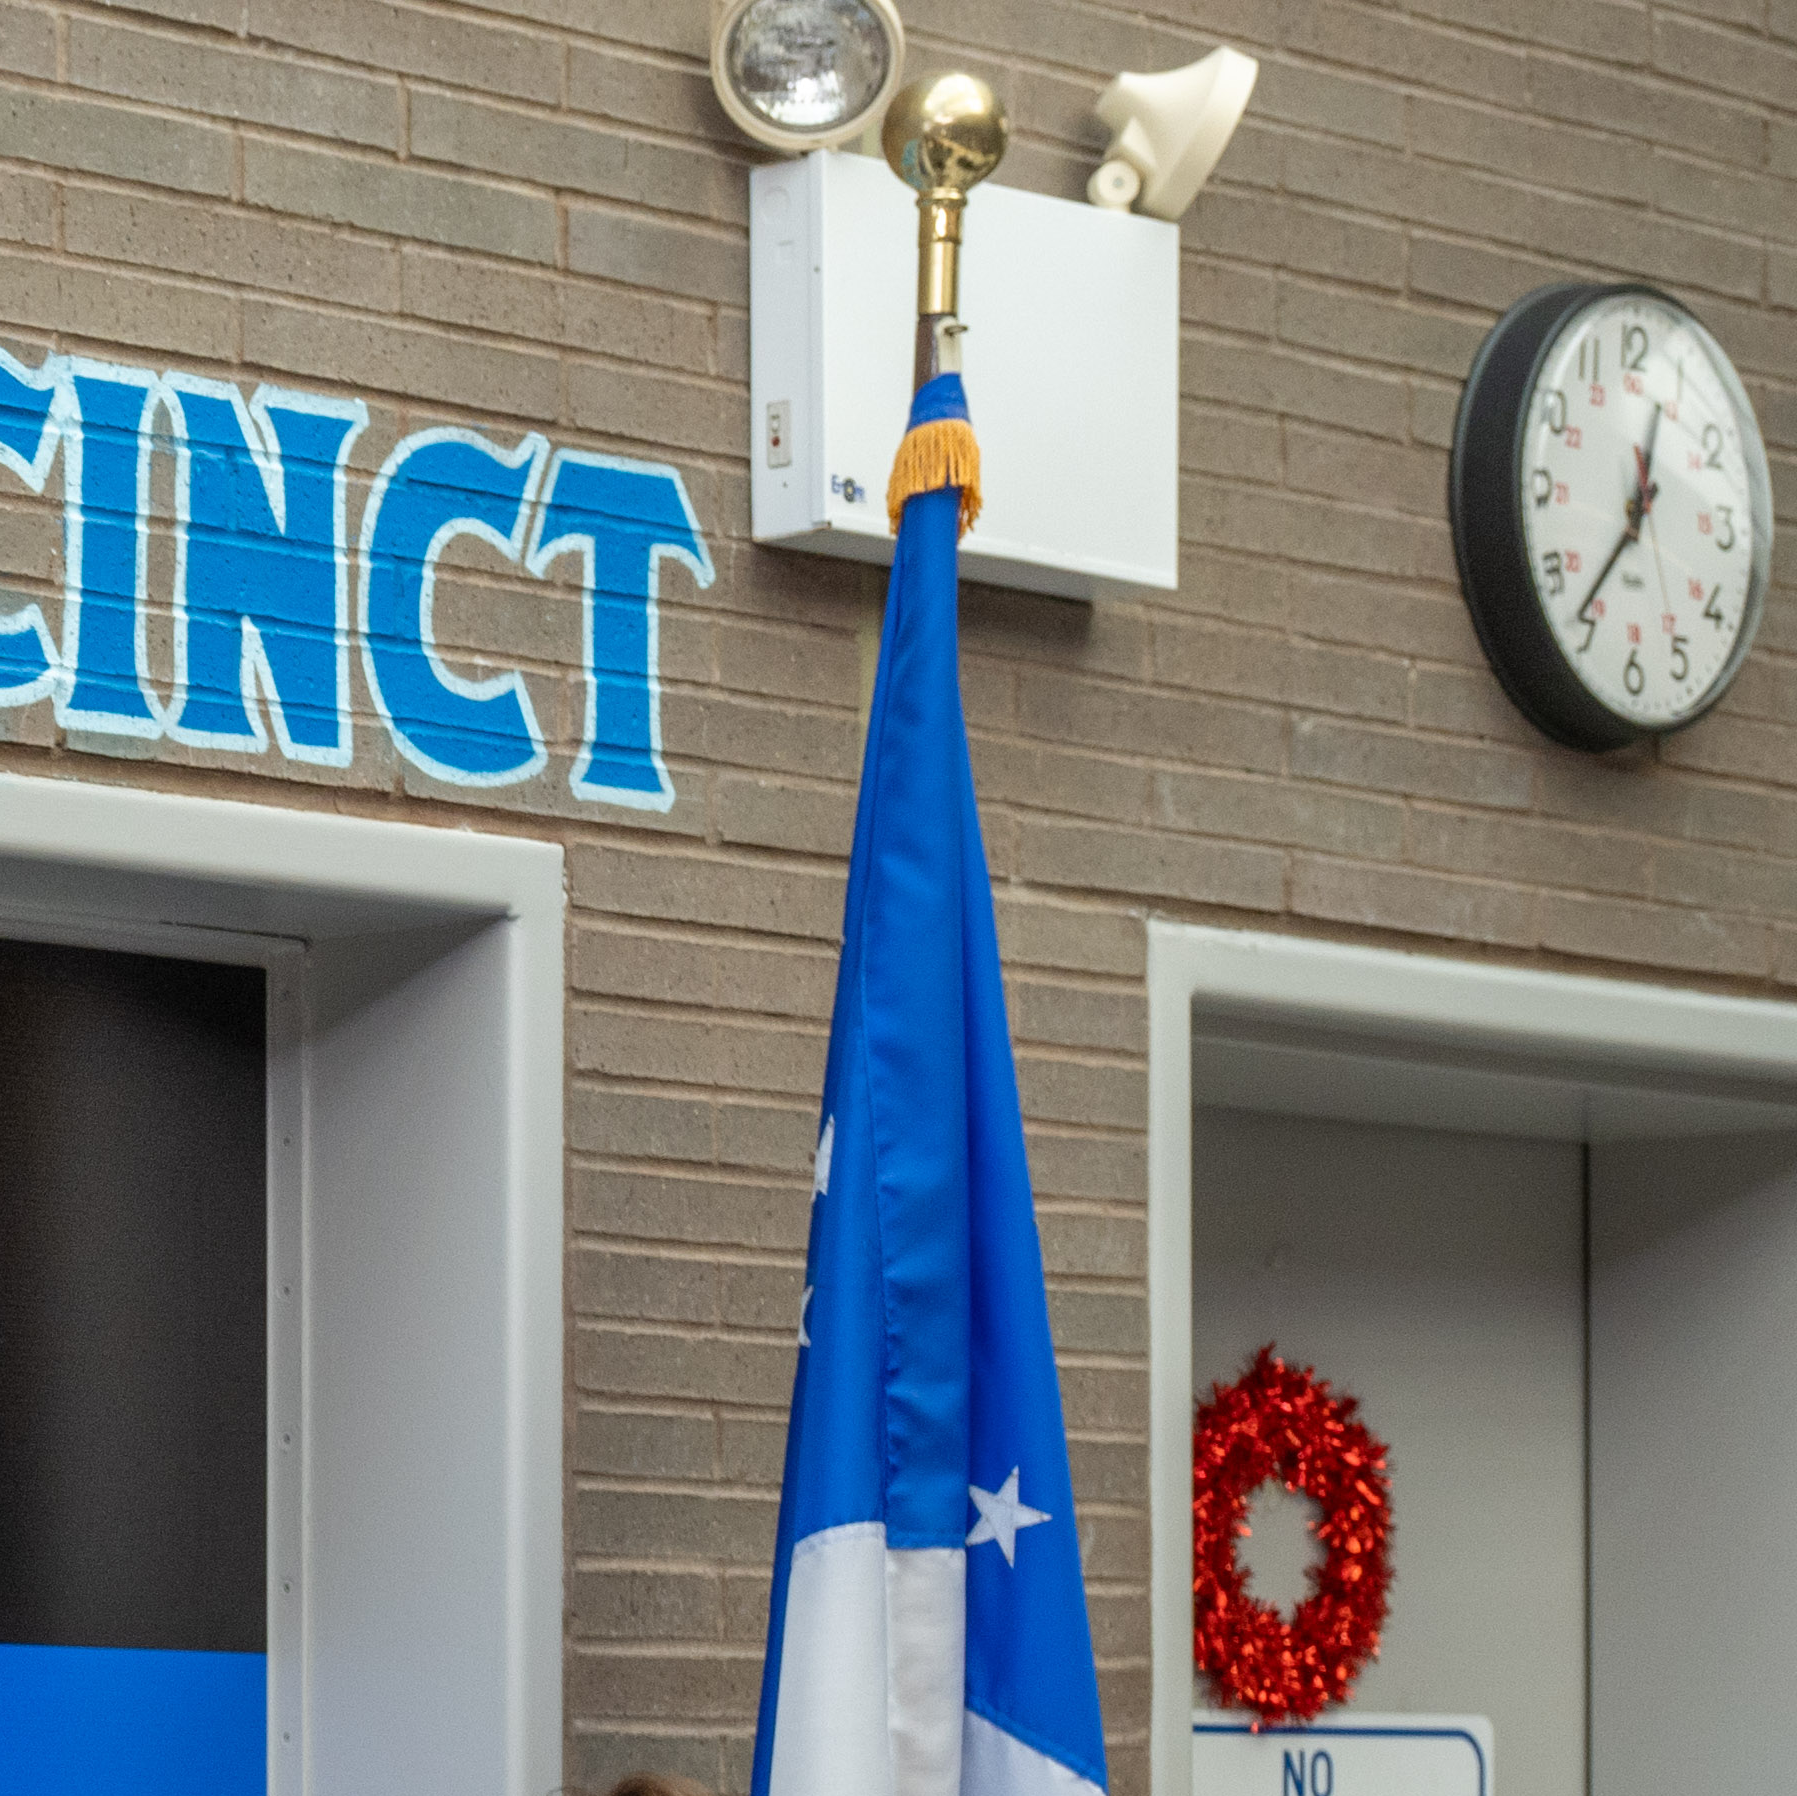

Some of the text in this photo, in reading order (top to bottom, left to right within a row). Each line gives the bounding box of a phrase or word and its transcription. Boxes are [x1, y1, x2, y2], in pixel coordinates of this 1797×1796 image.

[1578, 336, 1601, 382] 11
[1620, 323, 1649, 372] 12
[1702, 423, 1723, 470] 2
[1715, 505, 1736, 552] 3
[1703, 583, 1724, 631] 4
[1623, 648, 1645, 697] 6
[1669, 635, 1690, 681] 5
